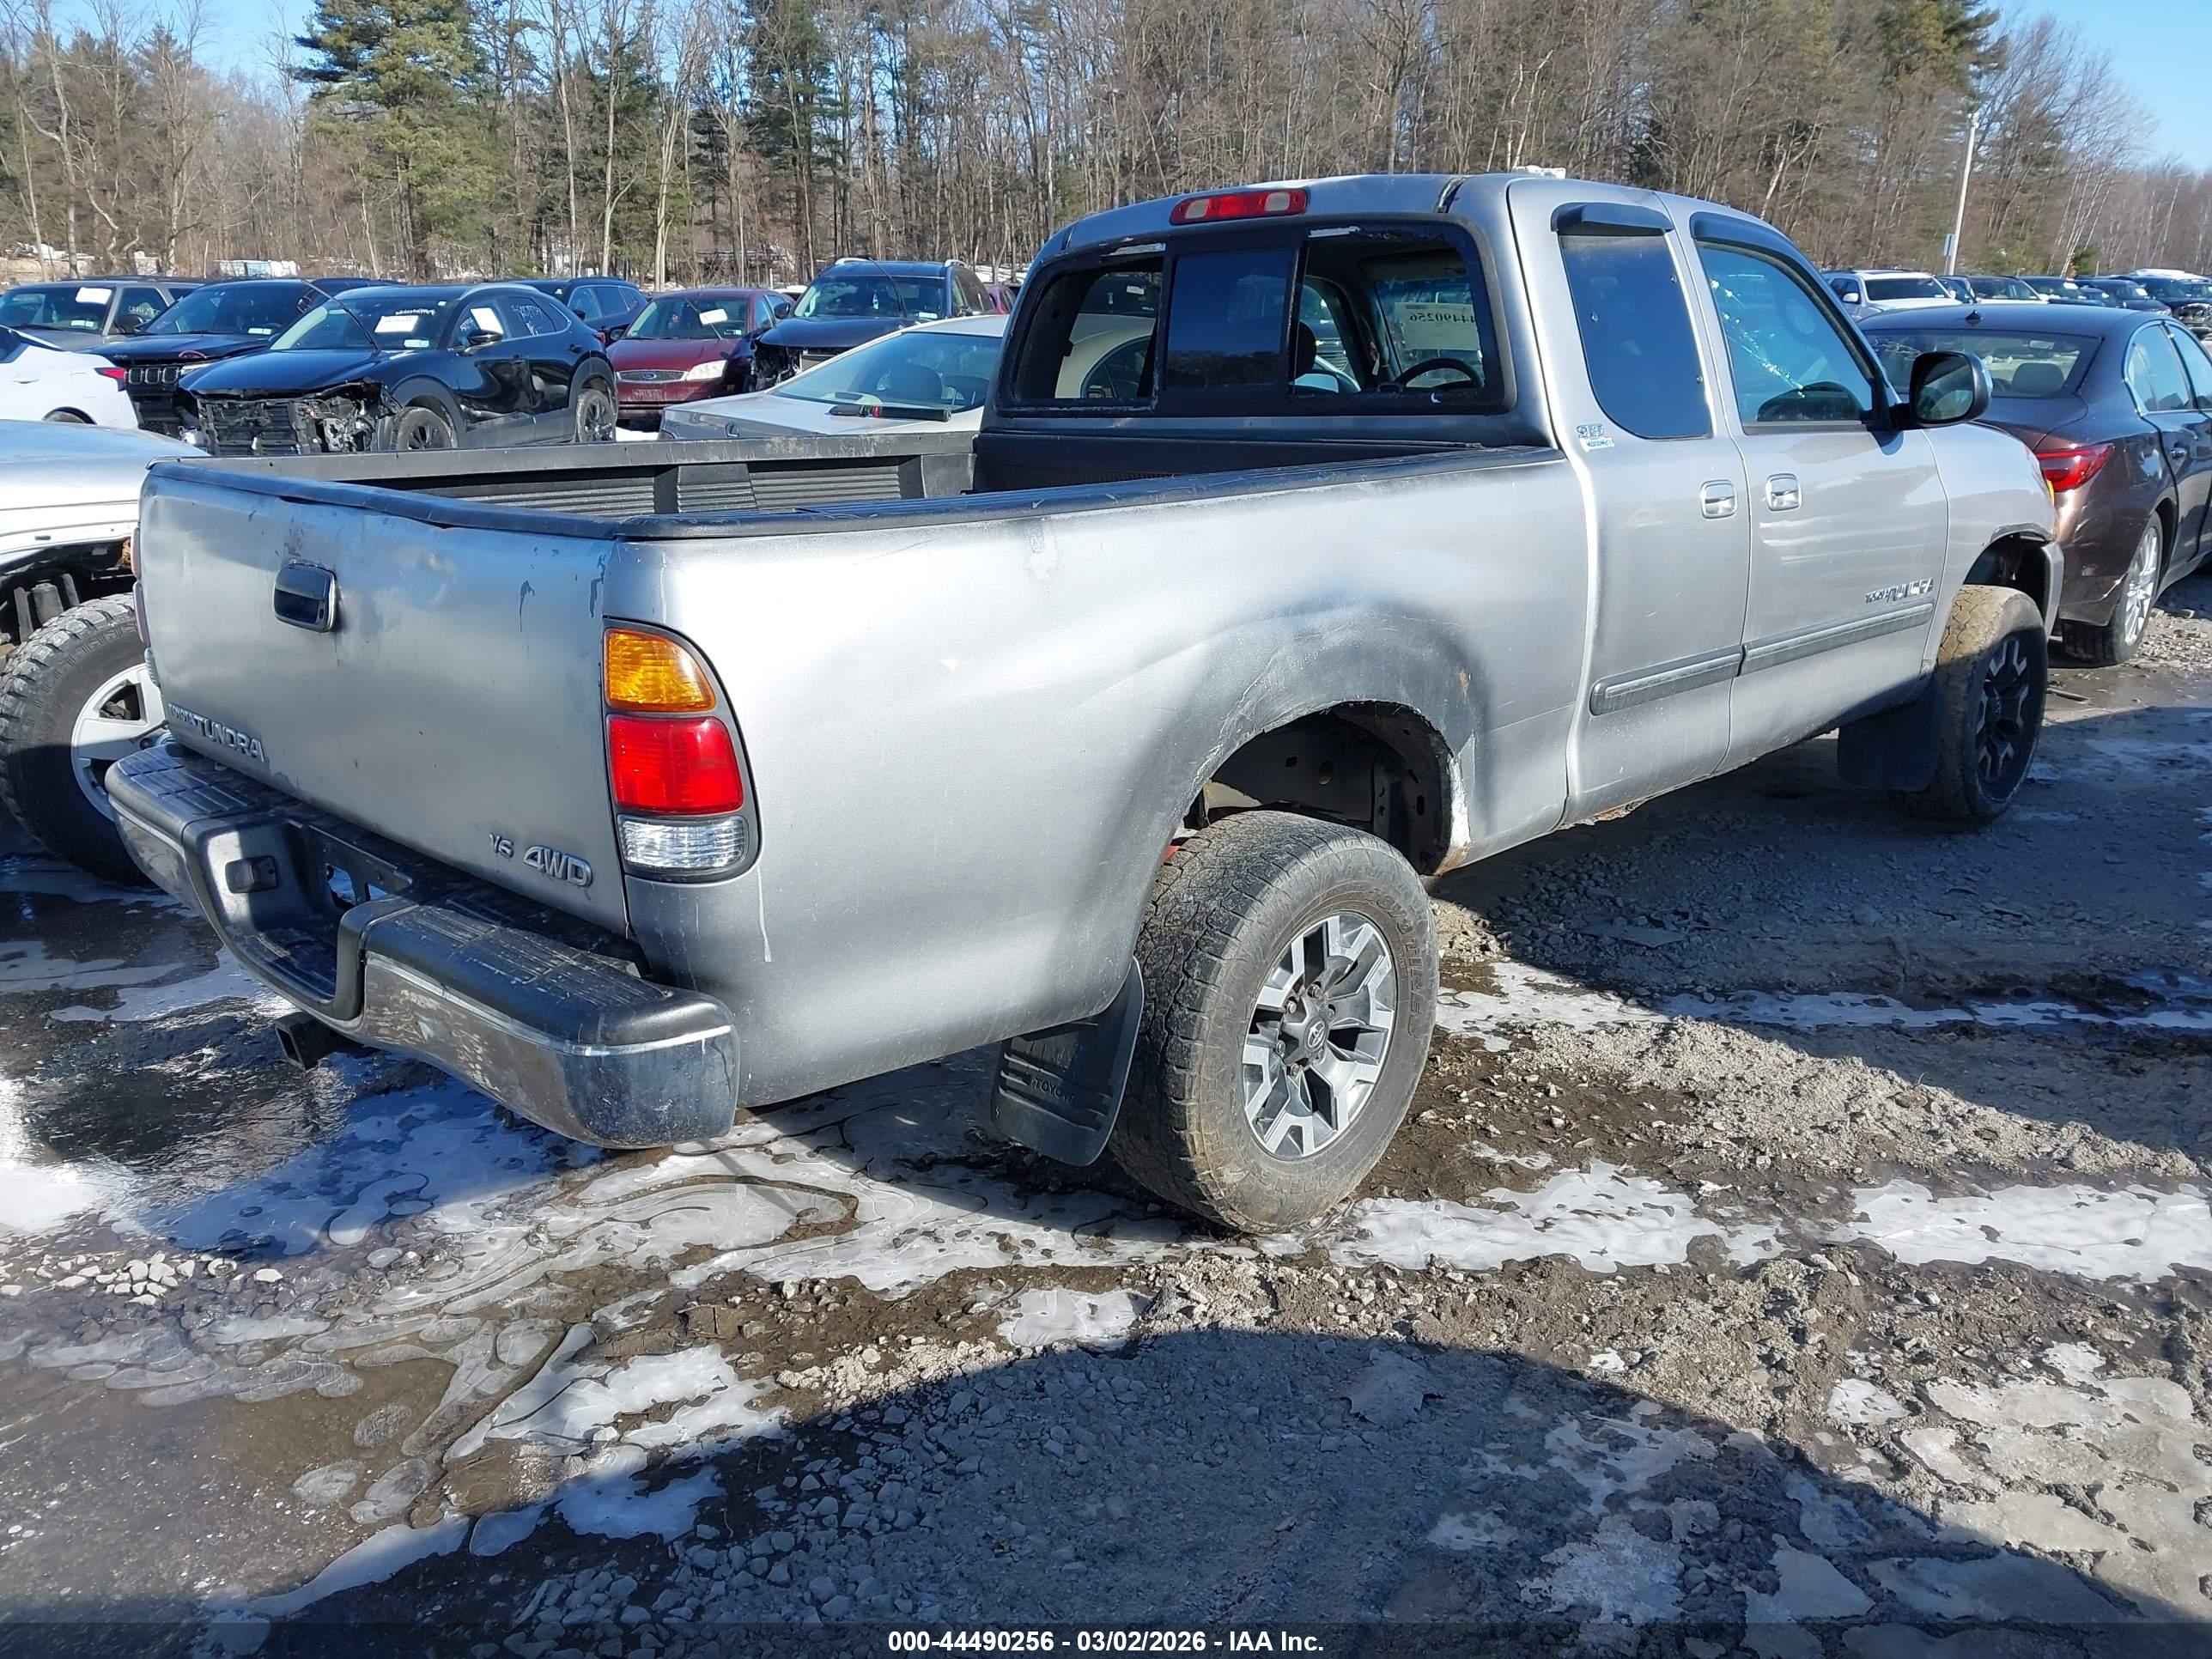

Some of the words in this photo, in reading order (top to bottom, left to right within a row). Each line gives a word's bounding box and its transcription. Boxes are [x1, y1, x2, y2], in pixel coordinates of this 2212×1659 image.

[168, 703, 198, 726] TOYOTA
[193, 714, 264, 763] TUNDRA
[523, 845, 592, 887] 4WD
